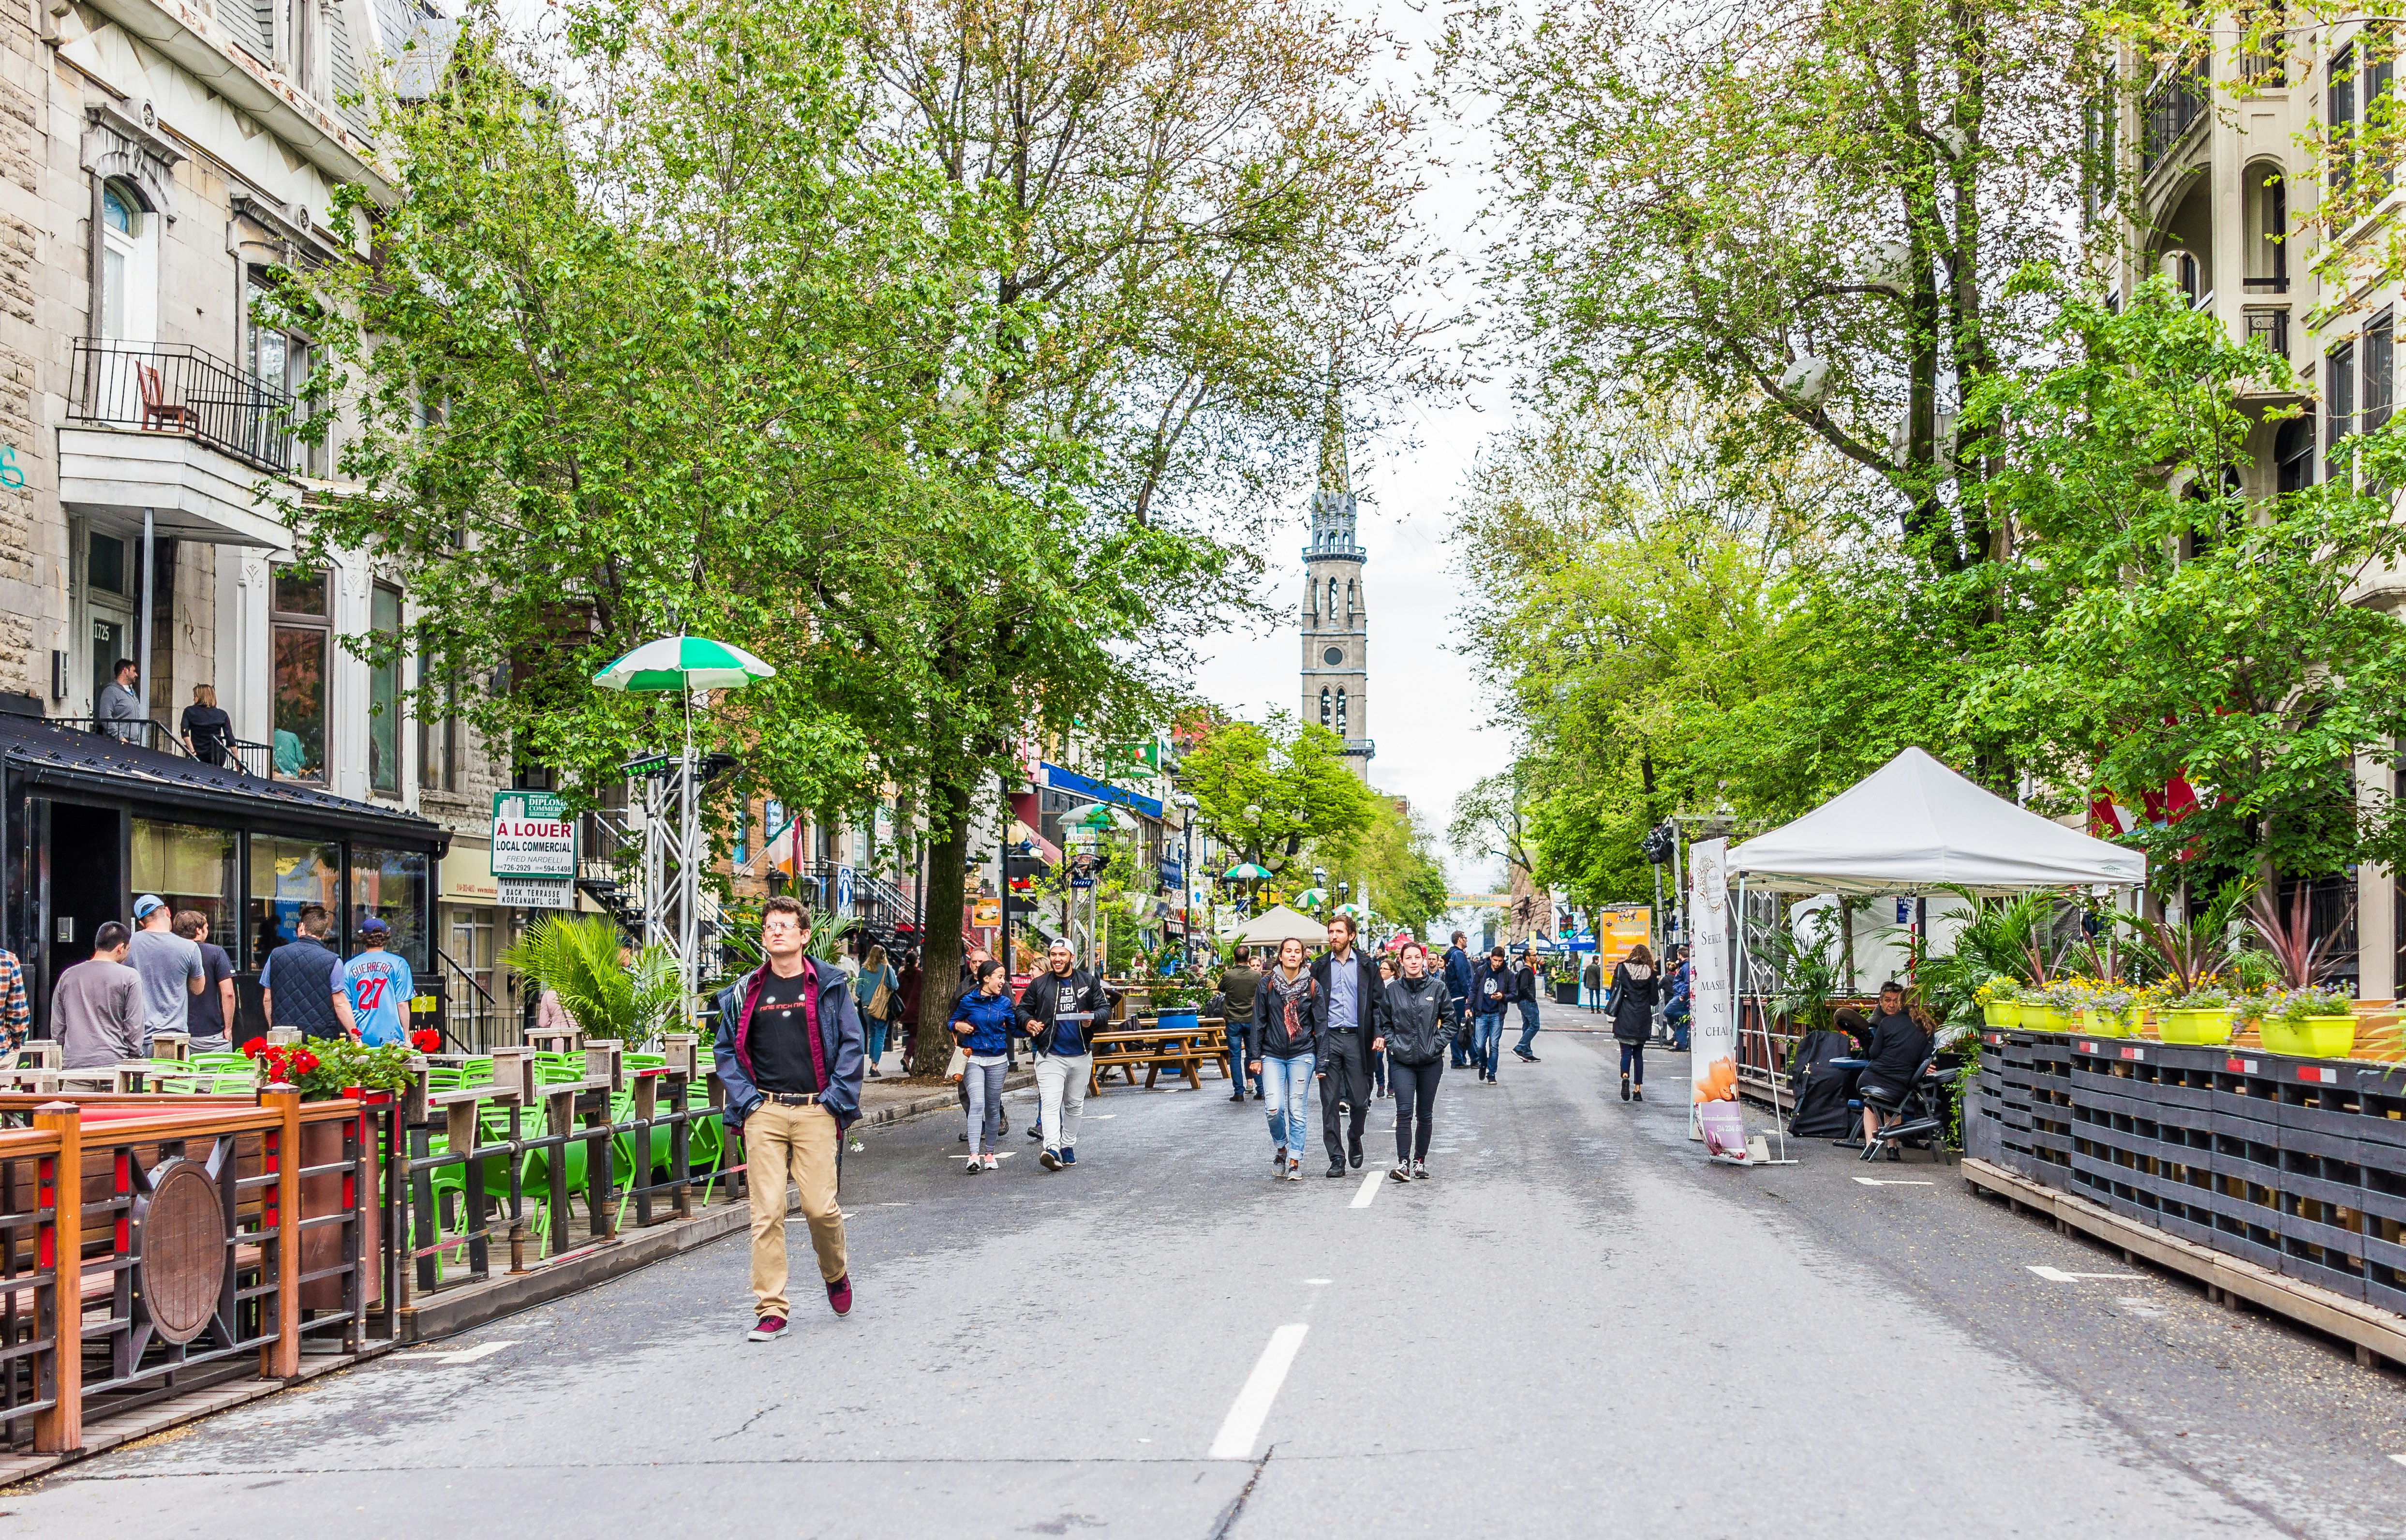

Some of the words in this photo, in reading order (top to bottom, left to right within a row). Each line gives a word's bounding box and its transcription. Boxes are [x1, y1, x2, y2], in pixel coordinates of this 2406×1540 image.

[94, 623, 109, 641] 1725
[497, 819, 508, 836] À
[514, 823, 571, 838] LOUER
[496, 841, 520, 851] LOCAL
[522, 842, 571, 852] COMMERCIAL
[527, 889, 560, 898] TERRASSE
[351, 962, 392, 977] GUERRERO
[356, 977, 388, 1011] 27
